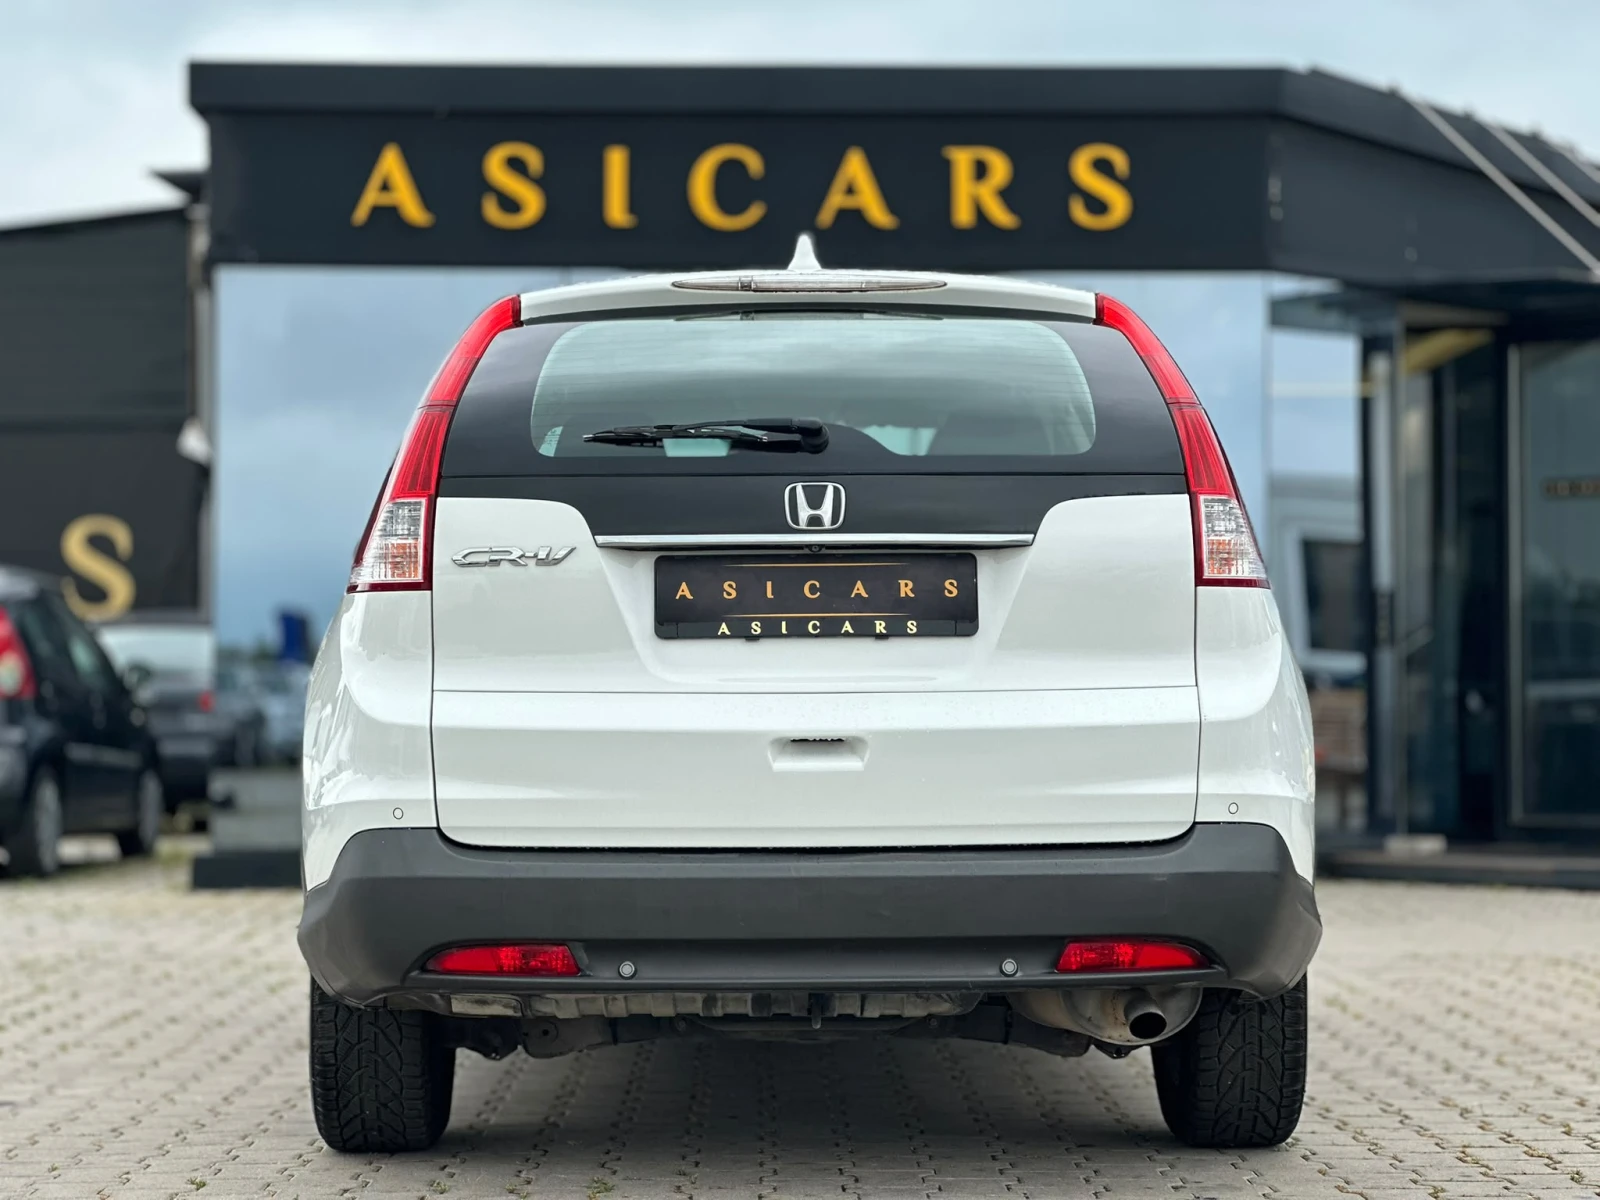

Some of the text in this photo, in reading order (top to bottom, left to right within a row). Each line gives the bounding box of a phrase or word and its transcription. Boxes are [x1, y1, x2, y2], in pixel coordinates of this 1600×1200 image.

[351, 142, 1134, 231] ASICARS
[452, 546, 576, 567] CR-V
[676, 578, 959, 600] ASICARS
[717, 620, 918, 636] ASICARS
